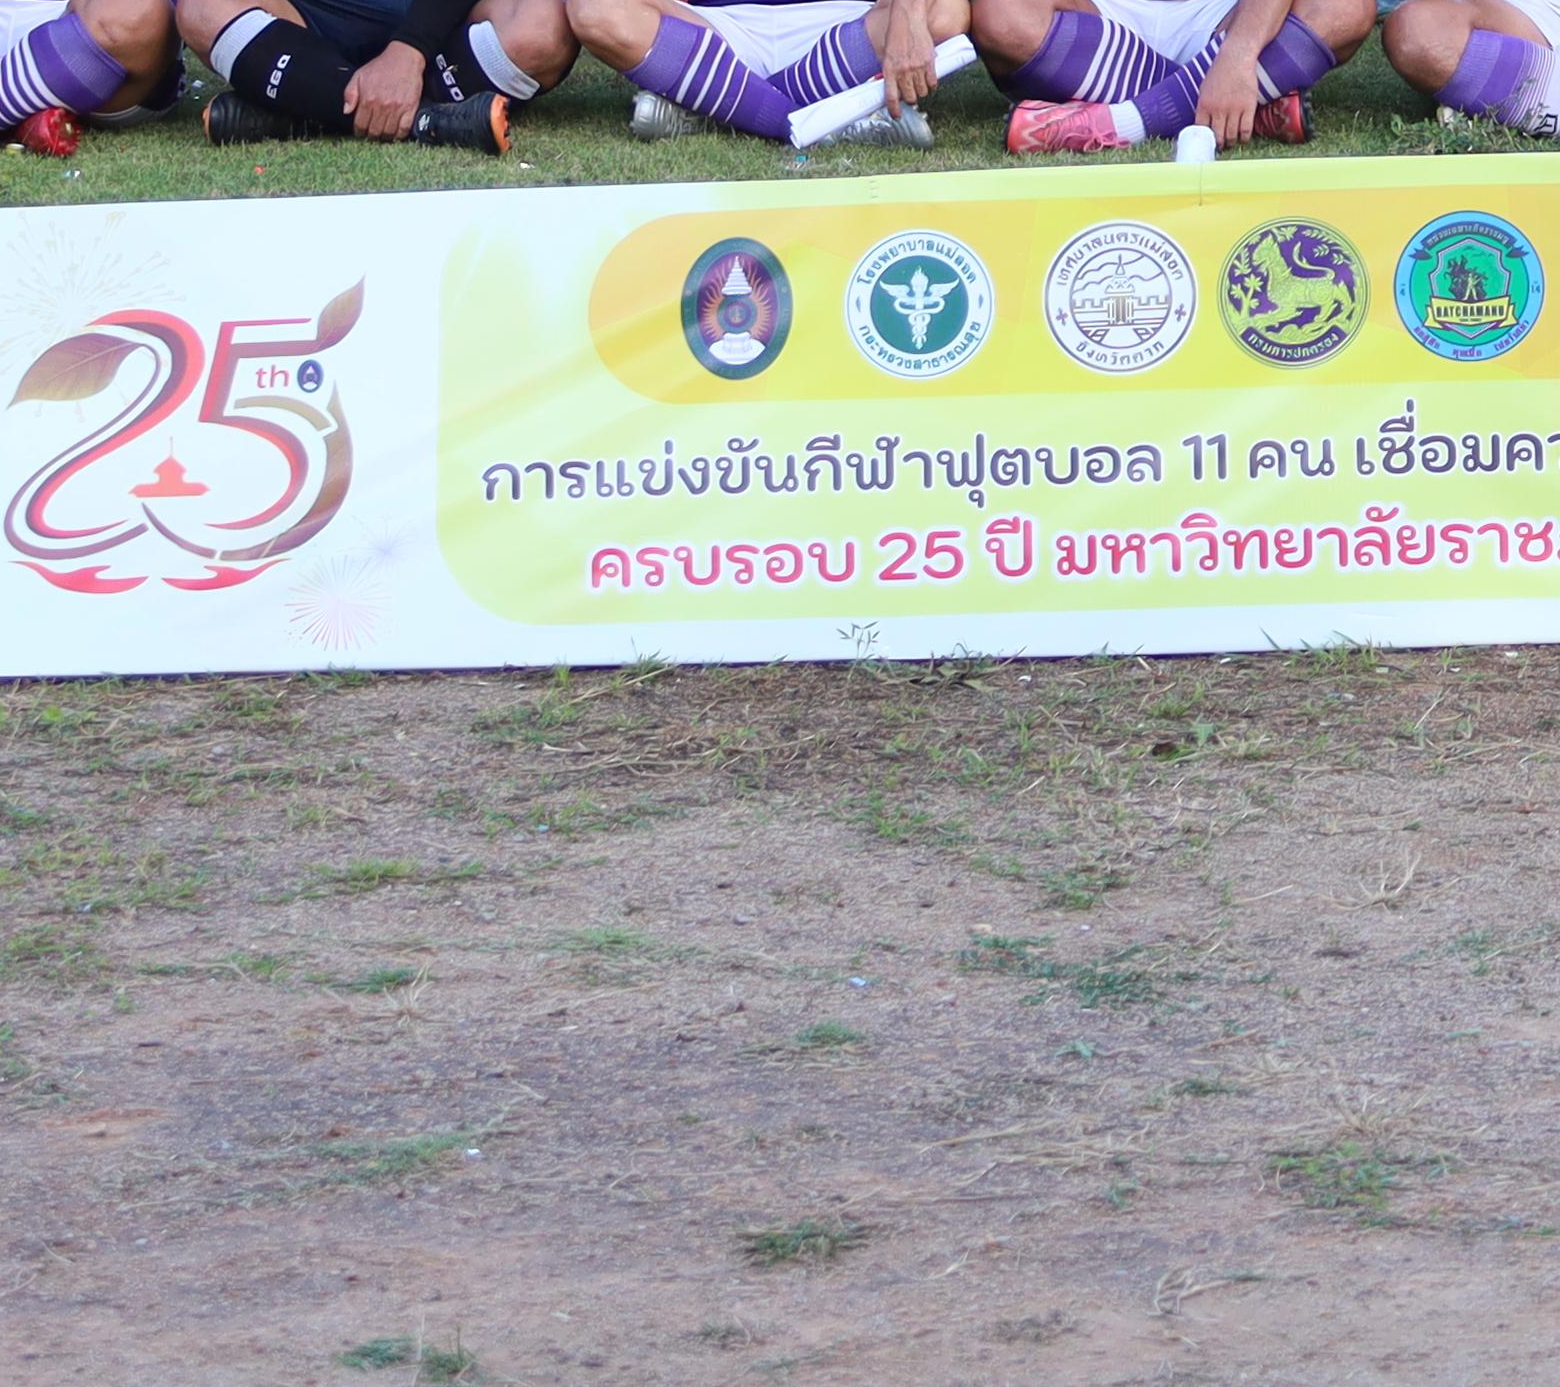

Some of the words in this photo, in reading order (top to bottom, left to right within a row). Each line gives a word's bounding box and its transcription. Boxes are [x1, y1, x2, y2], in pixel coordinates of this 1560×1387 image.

[265, 52, 292, 100] EGO
[254, 364, 291, 390] th
[482, 431, 1162, 509] การแข่งขันกีฬาฟุตบอล
[1182, 433, 1229, 482] 11
[1248, 435, 1336, 480] คน
[590, 540, 857, 591] ครบรอบ
[877, 530, 966, 581] 25
[985, 515, 1034, 578] ปี
